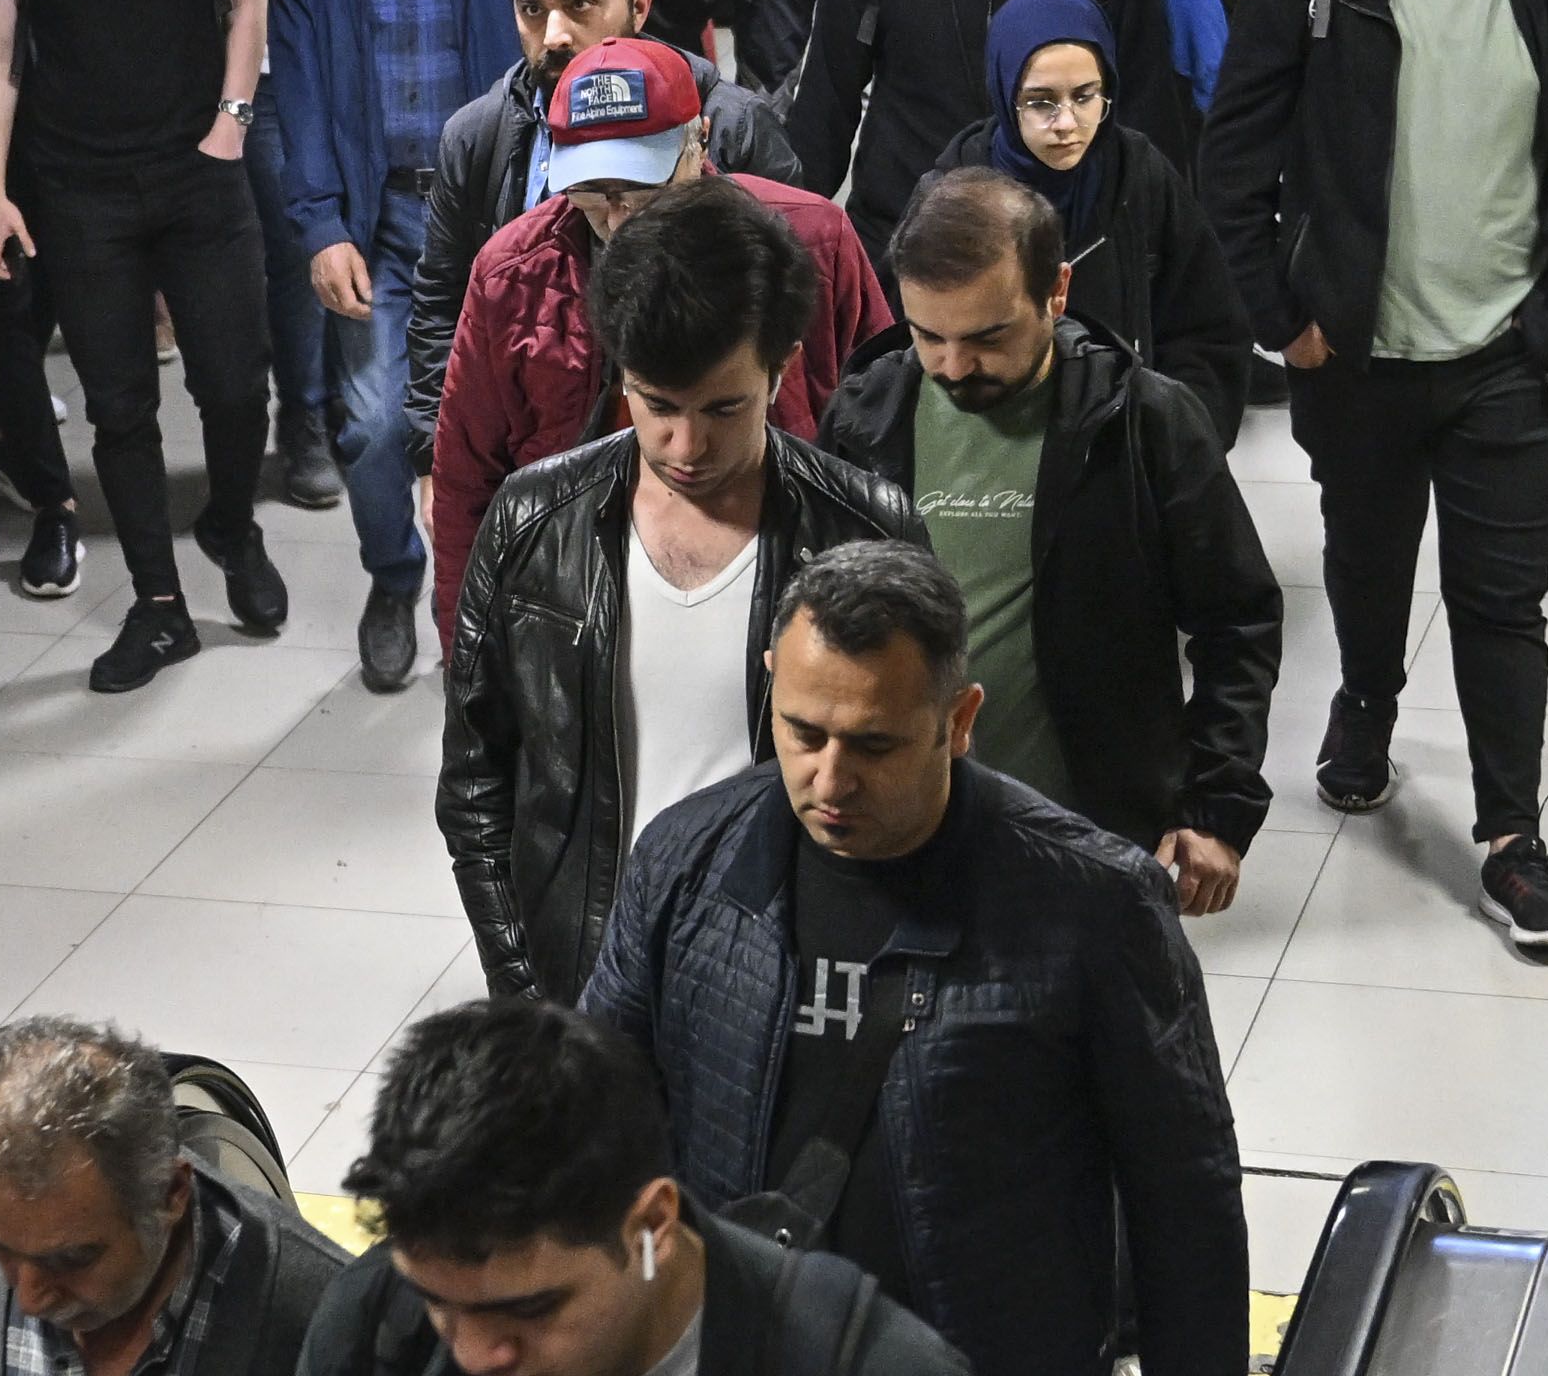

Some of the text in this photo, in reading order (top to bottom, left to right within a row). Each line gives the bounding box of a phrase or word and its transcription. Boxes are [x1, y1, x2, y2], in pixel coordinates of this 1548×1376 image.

[591, 74, 611, 87] THE
[580, 84, 611, 100] NORTH
[589, 94, 613, 107] FACE
[916, 490, 951, 516] Get
